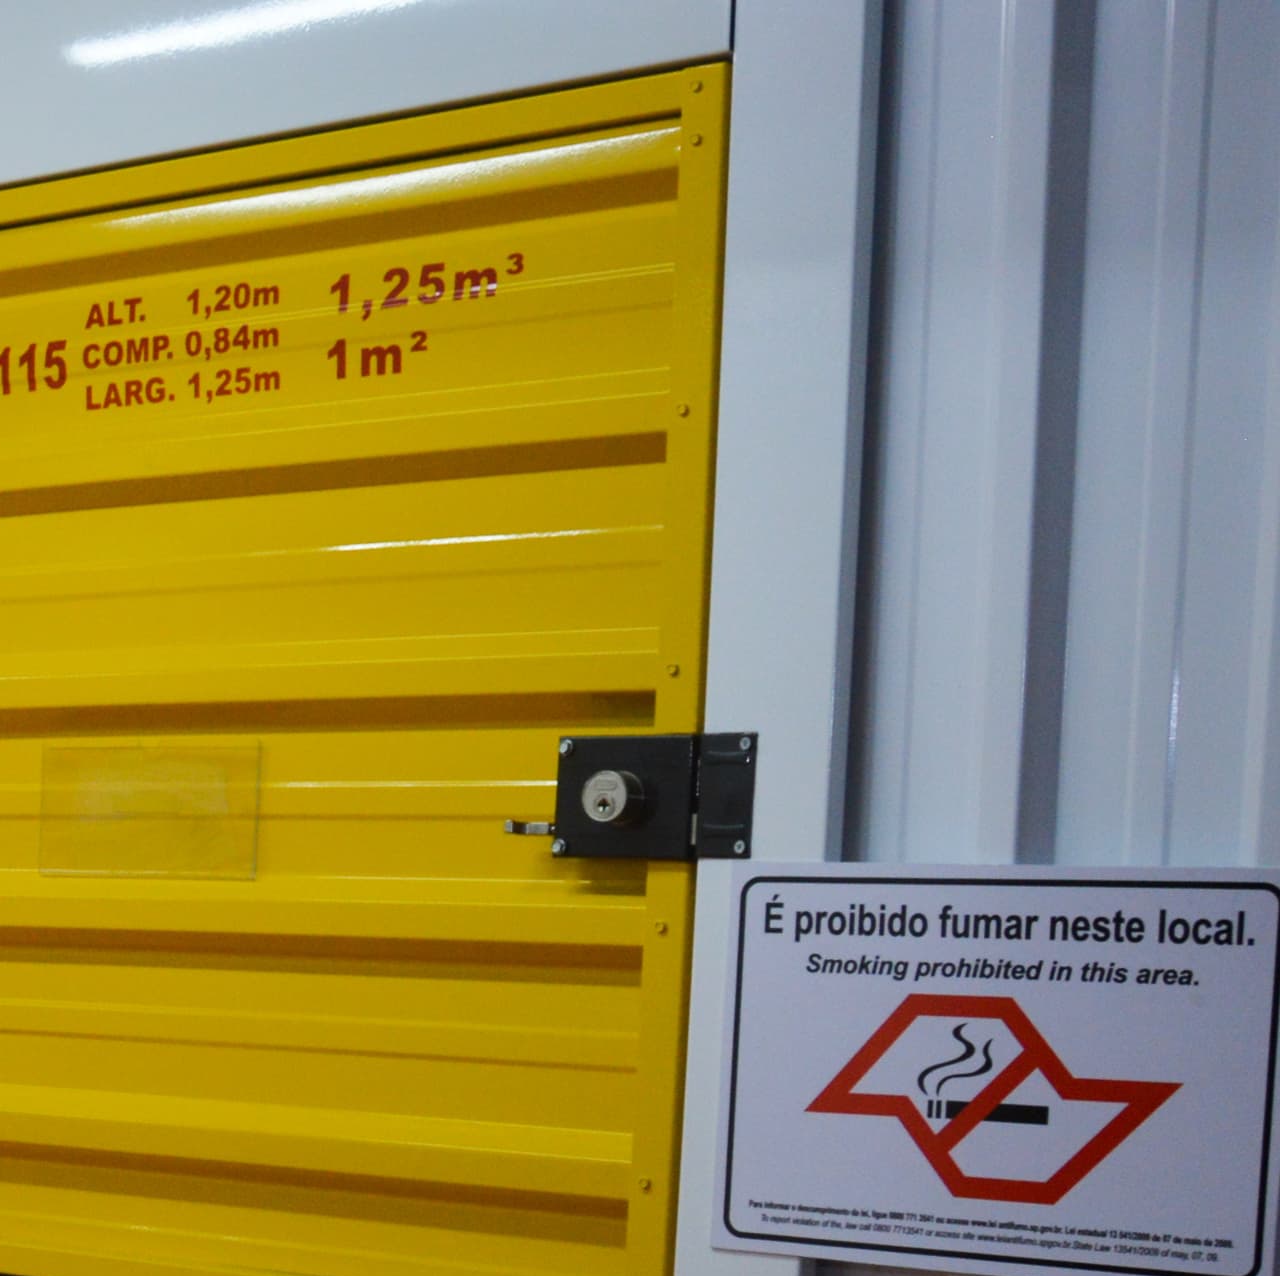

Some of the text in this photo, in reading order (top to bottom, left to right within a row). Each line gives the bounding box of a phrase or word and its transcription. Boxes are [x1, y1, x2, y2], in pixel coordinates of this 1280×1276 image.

[85, 281, 280, 329] ALT. 1,20m
[328, 253, 524, 322] 1,25m³
[82, 323, 279, 370] COMP. 0,84m
[326, 331, 428, 380] 1m²
[85, 367, 281, 410] LARG. 1,25m
[763, 895, 1256, 946] É proibido fumar neste local.
[806, 953, 1200, 986] Smoking prohibited in this area.
